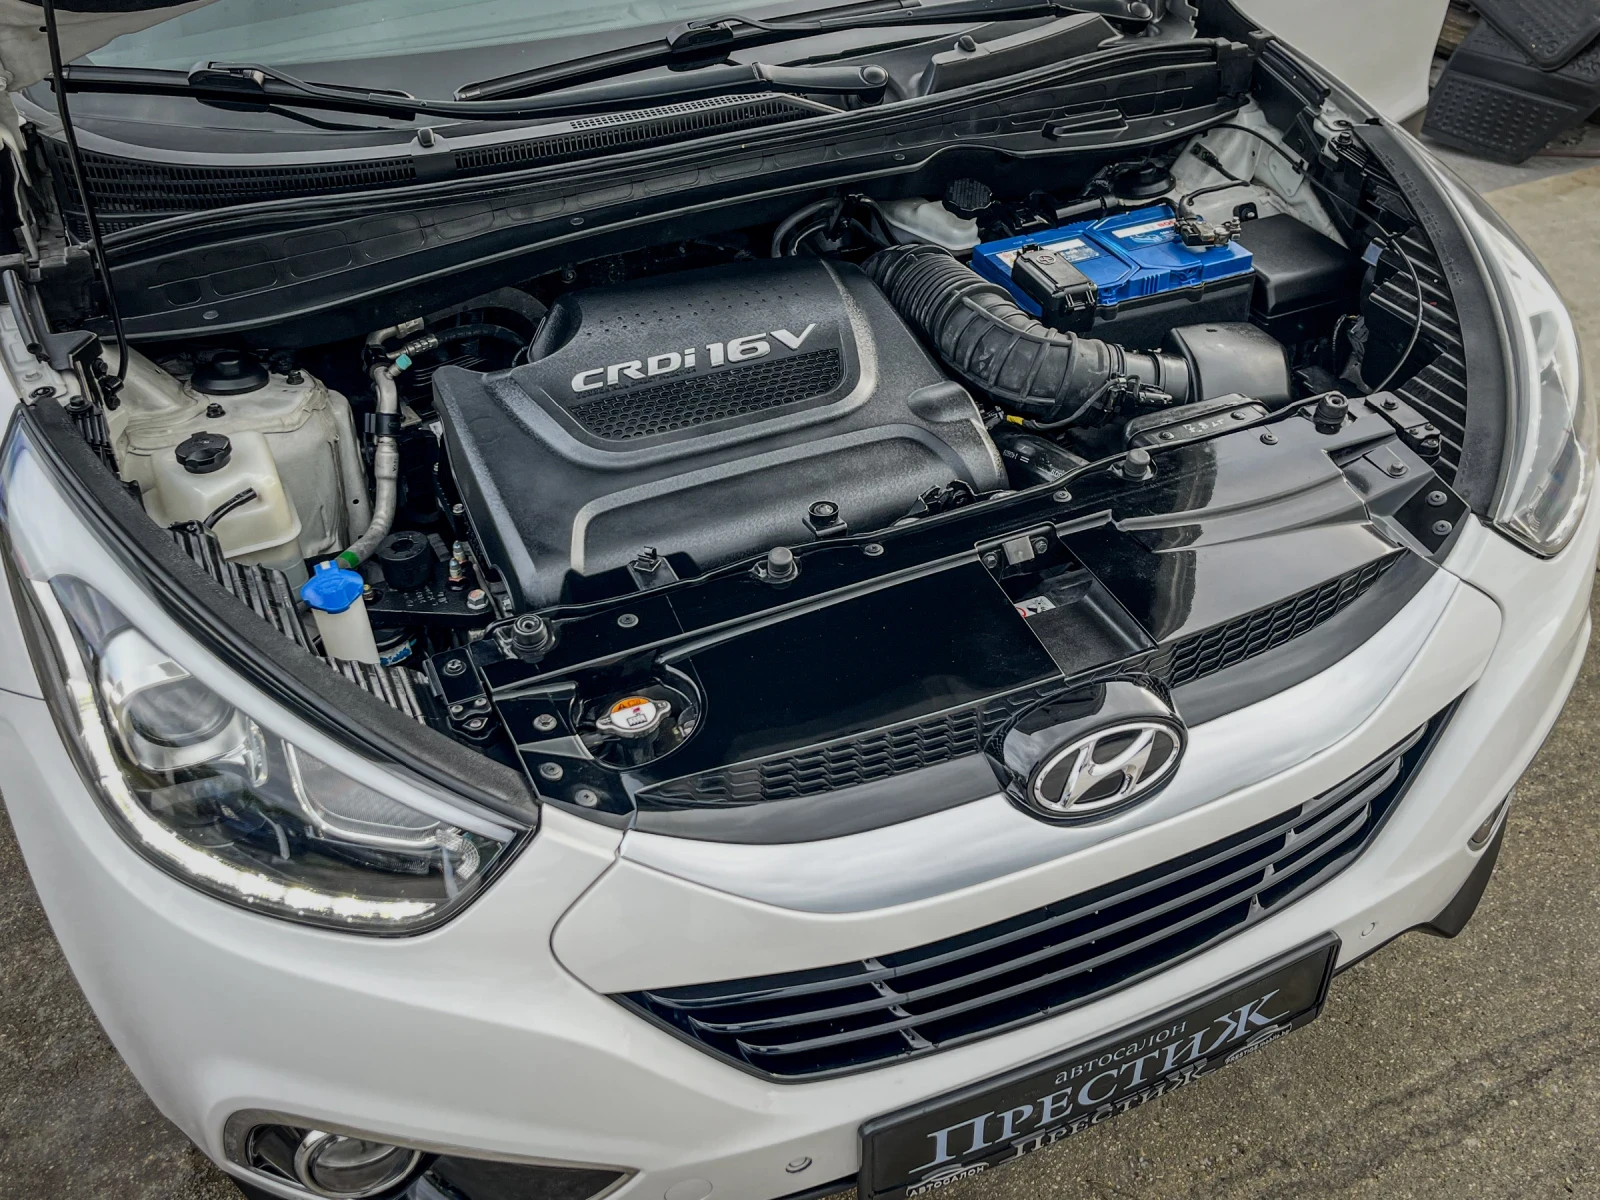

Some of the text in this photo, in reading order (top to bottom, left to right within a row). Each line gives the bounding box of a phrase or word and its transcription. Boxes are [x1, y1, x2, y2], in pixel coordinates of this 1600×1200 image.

[571, 323, 816, 392] CRDi 16V
[908, 988, 1290, 1174] ПРЕСТИЖ
[1055, 1021, 1187, 1085] автосалон
[909, 1165, 985, 1198] АВТОСАЛОН
